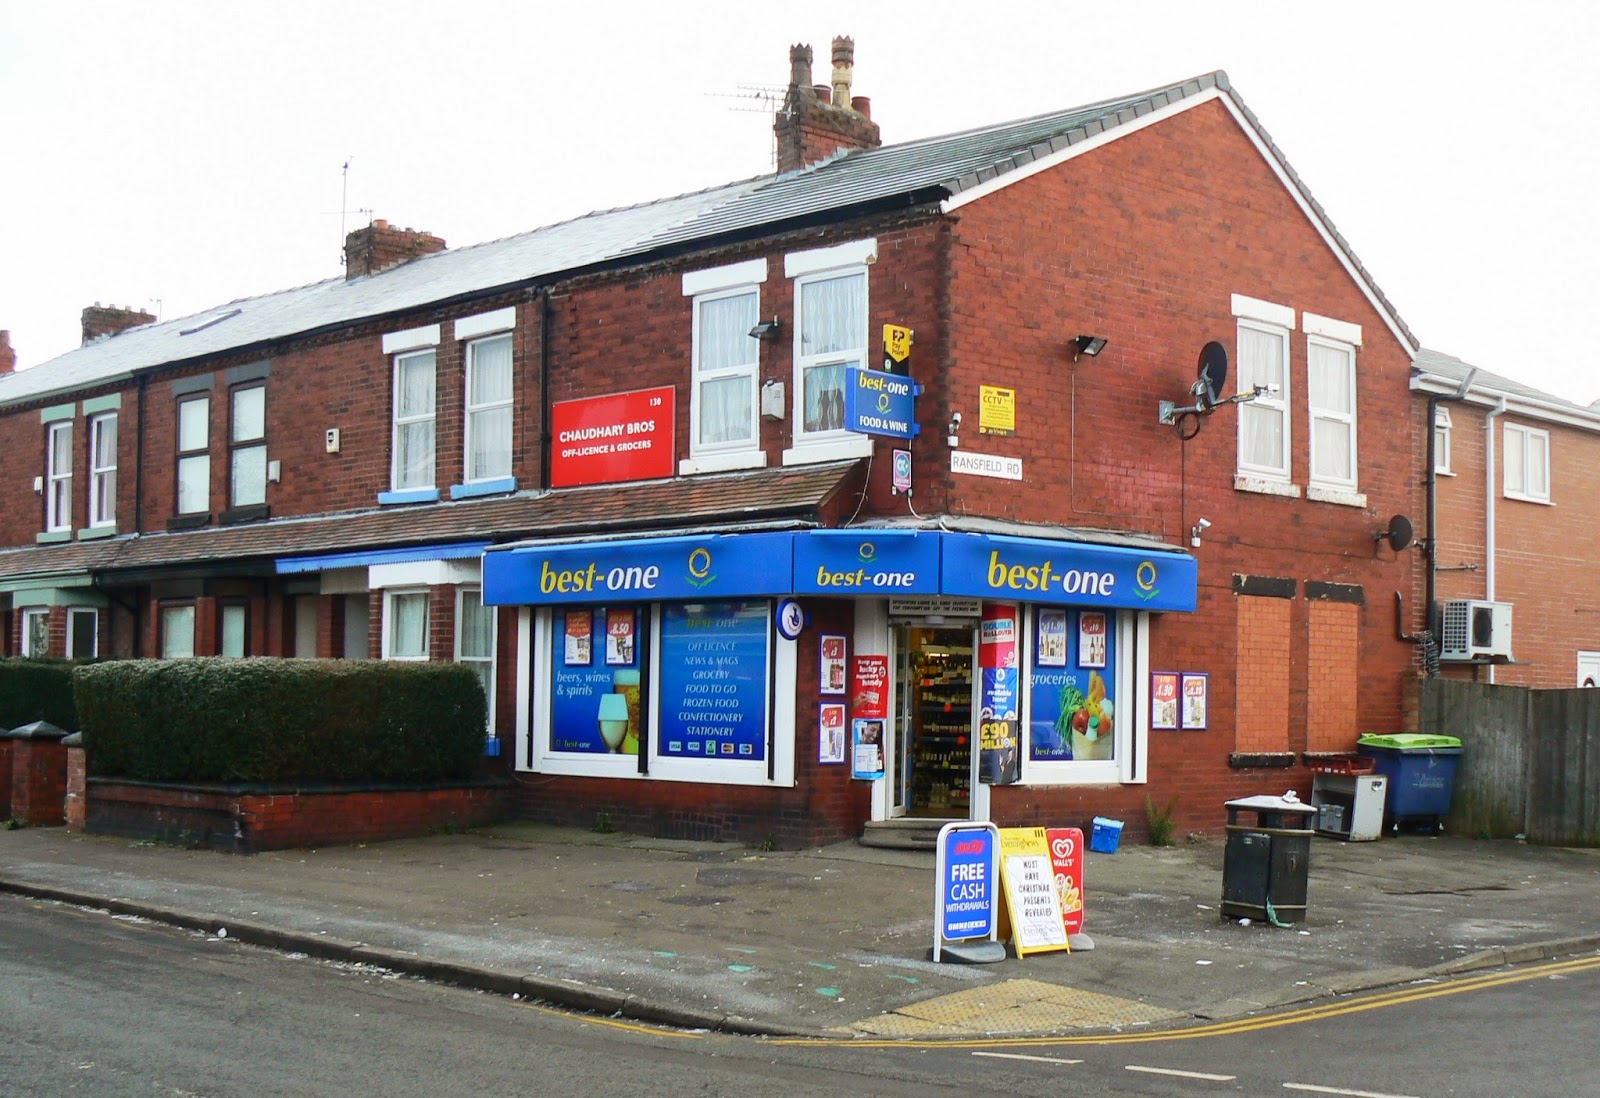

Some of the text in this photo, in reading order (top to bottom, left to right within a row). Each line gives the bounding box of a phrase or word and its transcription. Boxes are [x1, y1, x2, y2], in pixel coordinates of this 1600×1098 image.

[859, 371, 909, 396] best-one
[650, 397, 662, 407] 130
[983, 395, 1002, 405] CCTV
[559, 420, 655, 443] CHAUDHARY BROS
[859, 415, 908, 433] FOOD & WINE
[561, 439, 652, 459] OFF-LICENCE & GROCERS
[952, 456, 1002, 473] RANSFIELD
[539, 560, 660, 594] best-one
[816, 565, 915, 587] best-one
[987, 550, 1115, 597] best-one
[982, 620, 1012, 631] DOUBLE
[684, 656, 739, 666] NEWS & MAGS
[557, 670, 611, 683] beers, wines
[692, 670, 730, 680] GROCERY
[1030, 671, 1077, 688] groceries
[556, 683, 593, 699] & spirits
[685, 684, 737, 695] FOOD TO GO
[682, 698, 740, 709] FROZEN FOOD
[678, 711, 744, 723] CONFECTIONERY
[686, 726, 735, 737] STATIONERY
[981, 721, 1009, 741] £90
[980, 736, 1016, 750] MILLION
[951, 862, 985, 882] FREE
[951, 882, 985, 901] CASH
[945, 900, 990, 913] WITHDRAWALS
